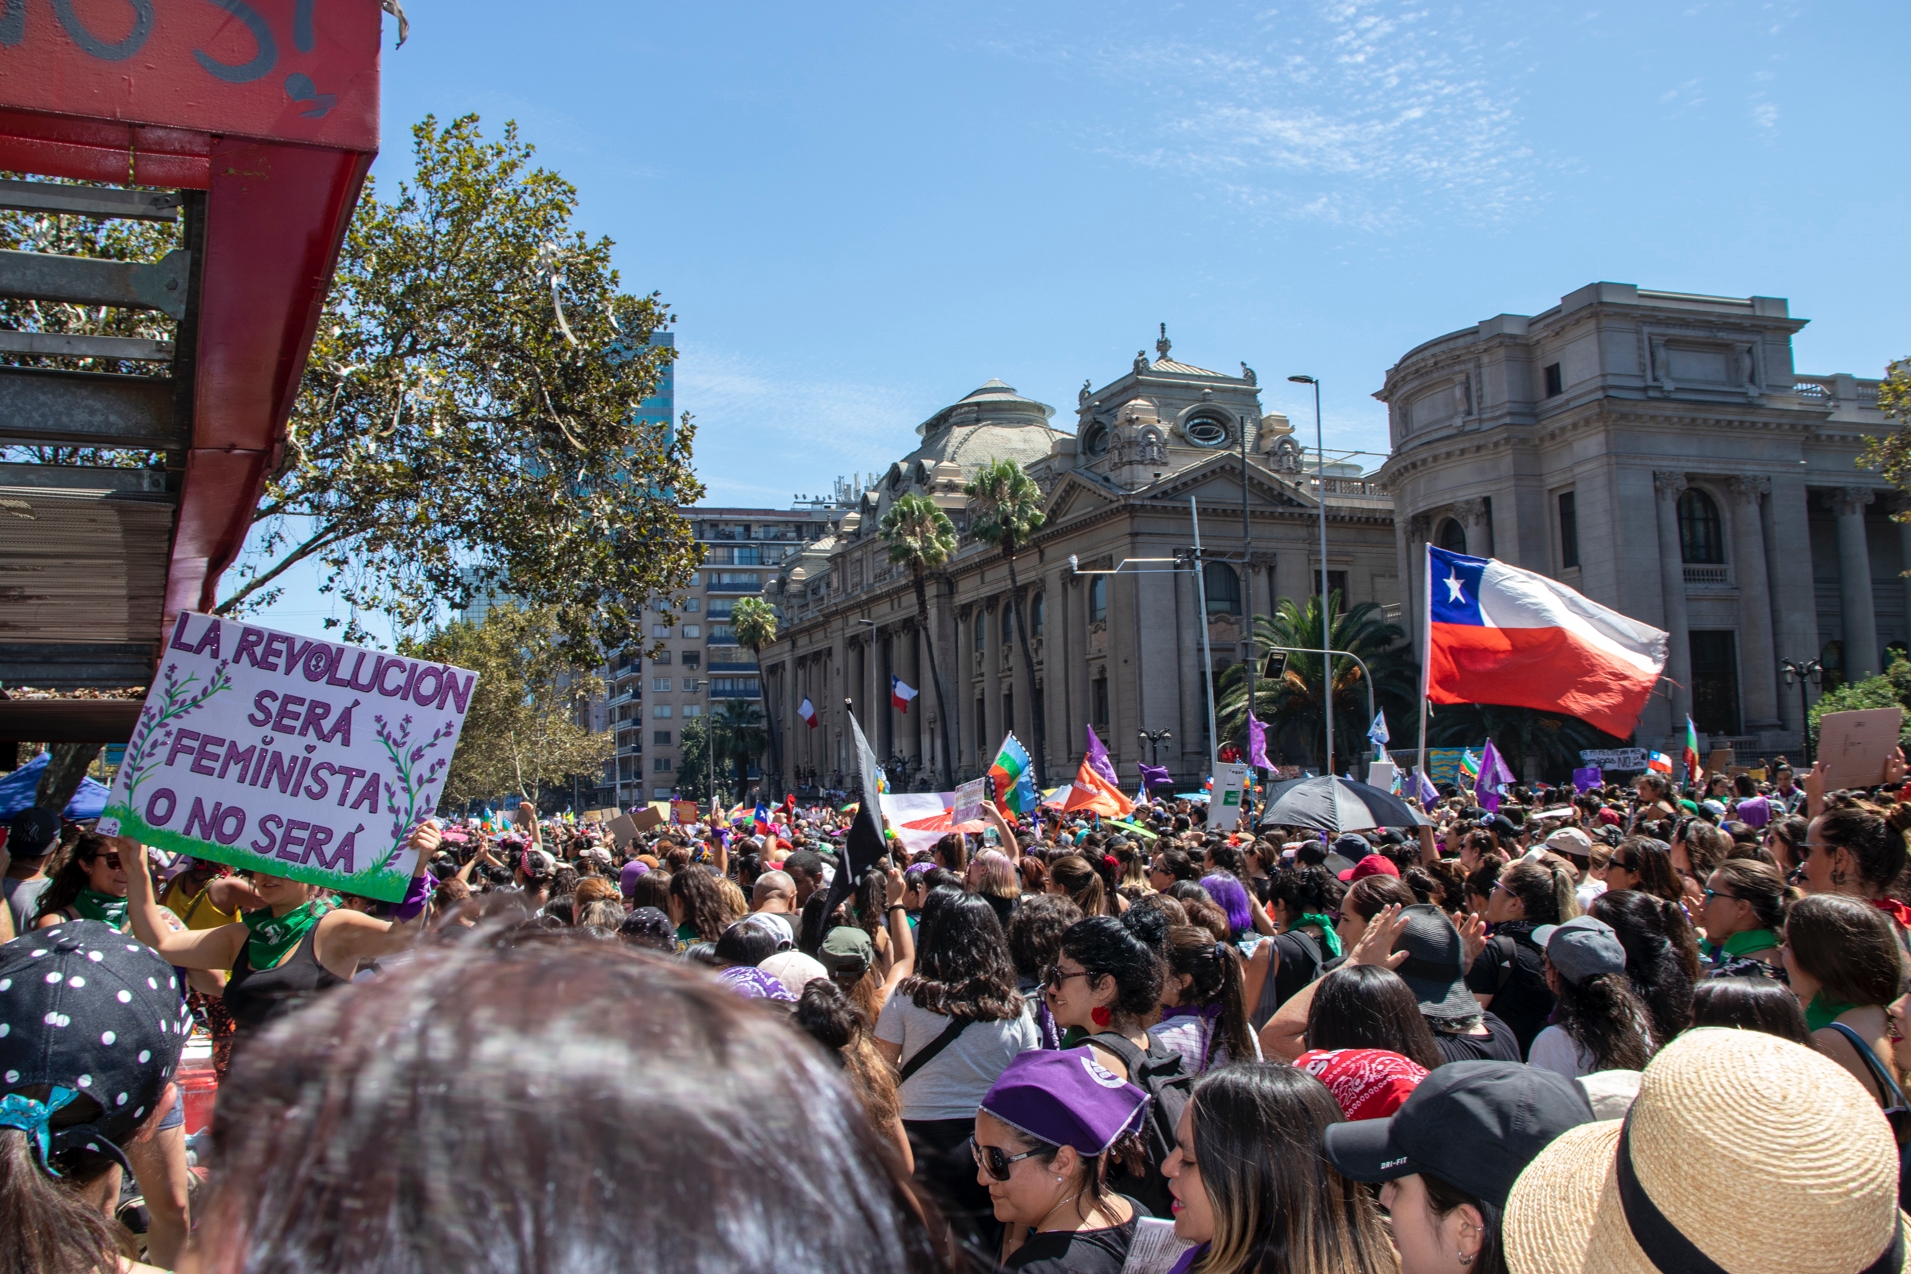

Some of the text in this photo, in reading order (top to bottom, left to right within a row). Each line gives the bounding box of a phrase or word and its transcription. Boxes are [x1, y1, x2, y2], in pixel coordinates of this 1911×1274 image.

[170, 612, 474, 714] LA REVOLUCIÓN
[247, 690, 361, 747] SERÁ
[164, 727, 381, 814] FEMINISTA
[1617, 756, 1631, 768] NO
[145, 787, 365, 873] O NO SERÁ
[1380, 1156, 1408, 1169] DRI-FIT
